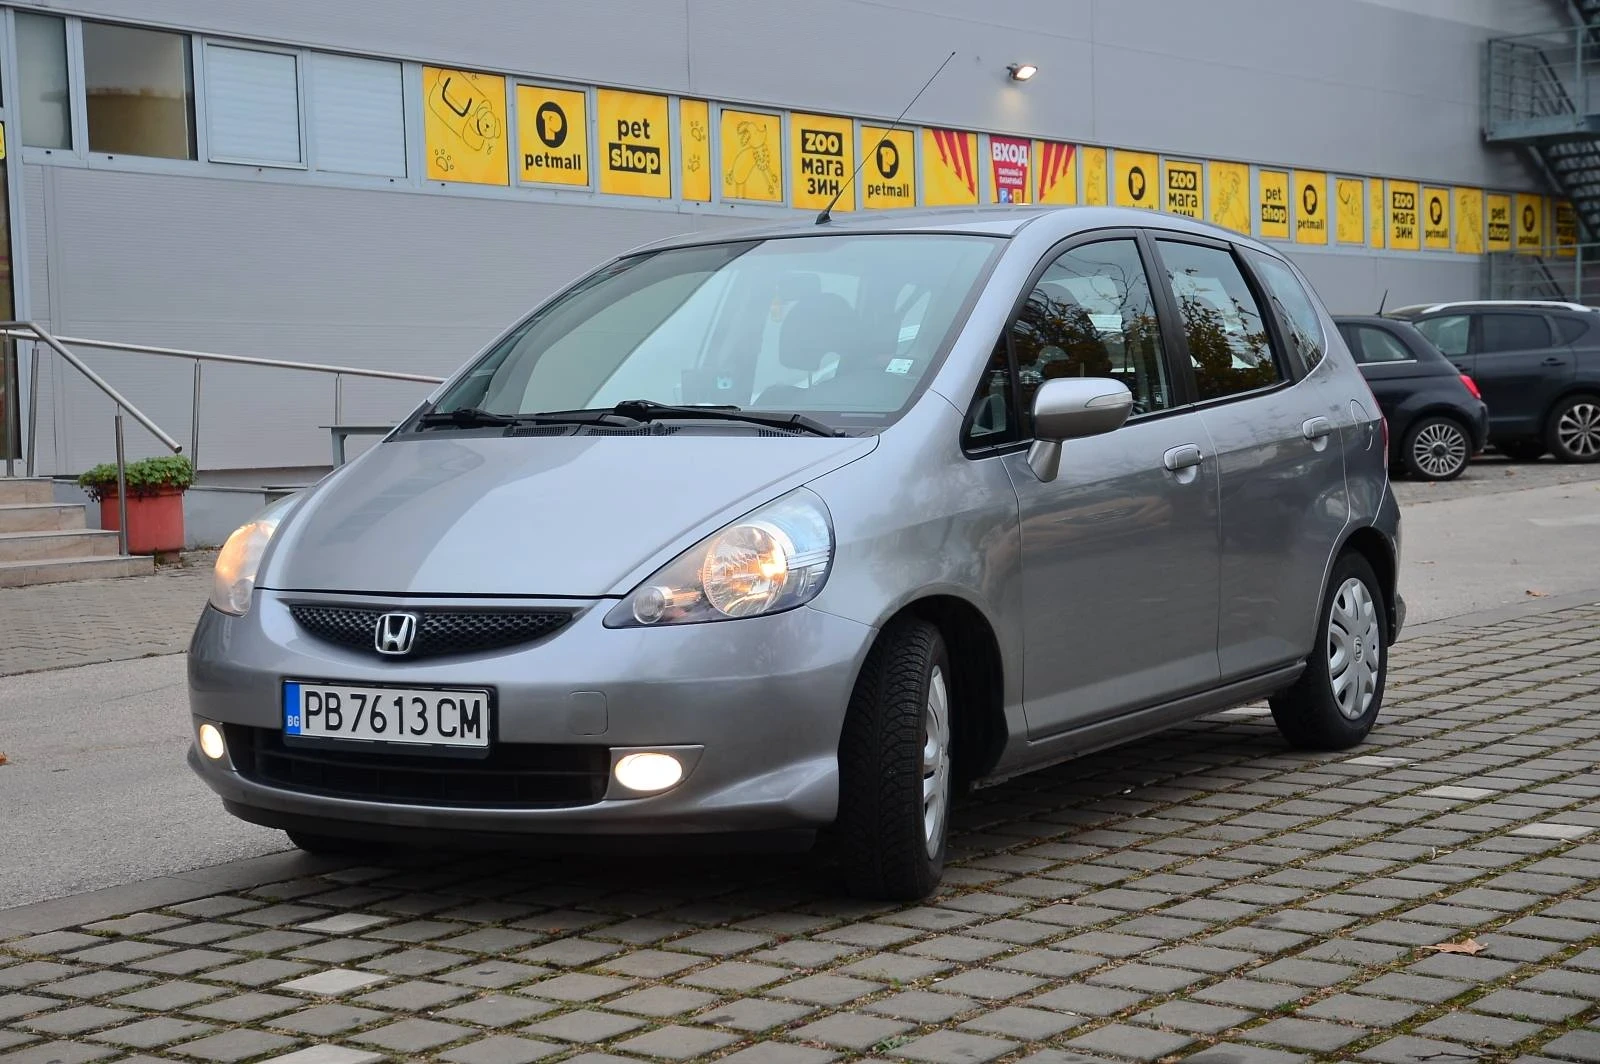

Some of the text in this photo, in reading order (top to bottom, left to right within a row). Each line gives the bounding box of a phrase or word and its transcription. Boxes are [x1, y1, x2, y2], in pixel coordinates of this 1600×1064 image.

[617, 118, 650, 140] pet
[524, 152, 582, 171] petmall
[611, 146, 660, 174] shop
[992, 142, 1028, 167] ВХОД
[801, 157, 844, 177] мага
[807, 178, 840, 196] зин
[868, 183, 910, 198] petmall
[1265, 186, 1282, 201] pet
[1168, 192, 1198, 208] мага
[1261, 205, 1287, 223] shop
[1297, 219, 1325, 230] petmall
[287, 715, 300, 728] BG
